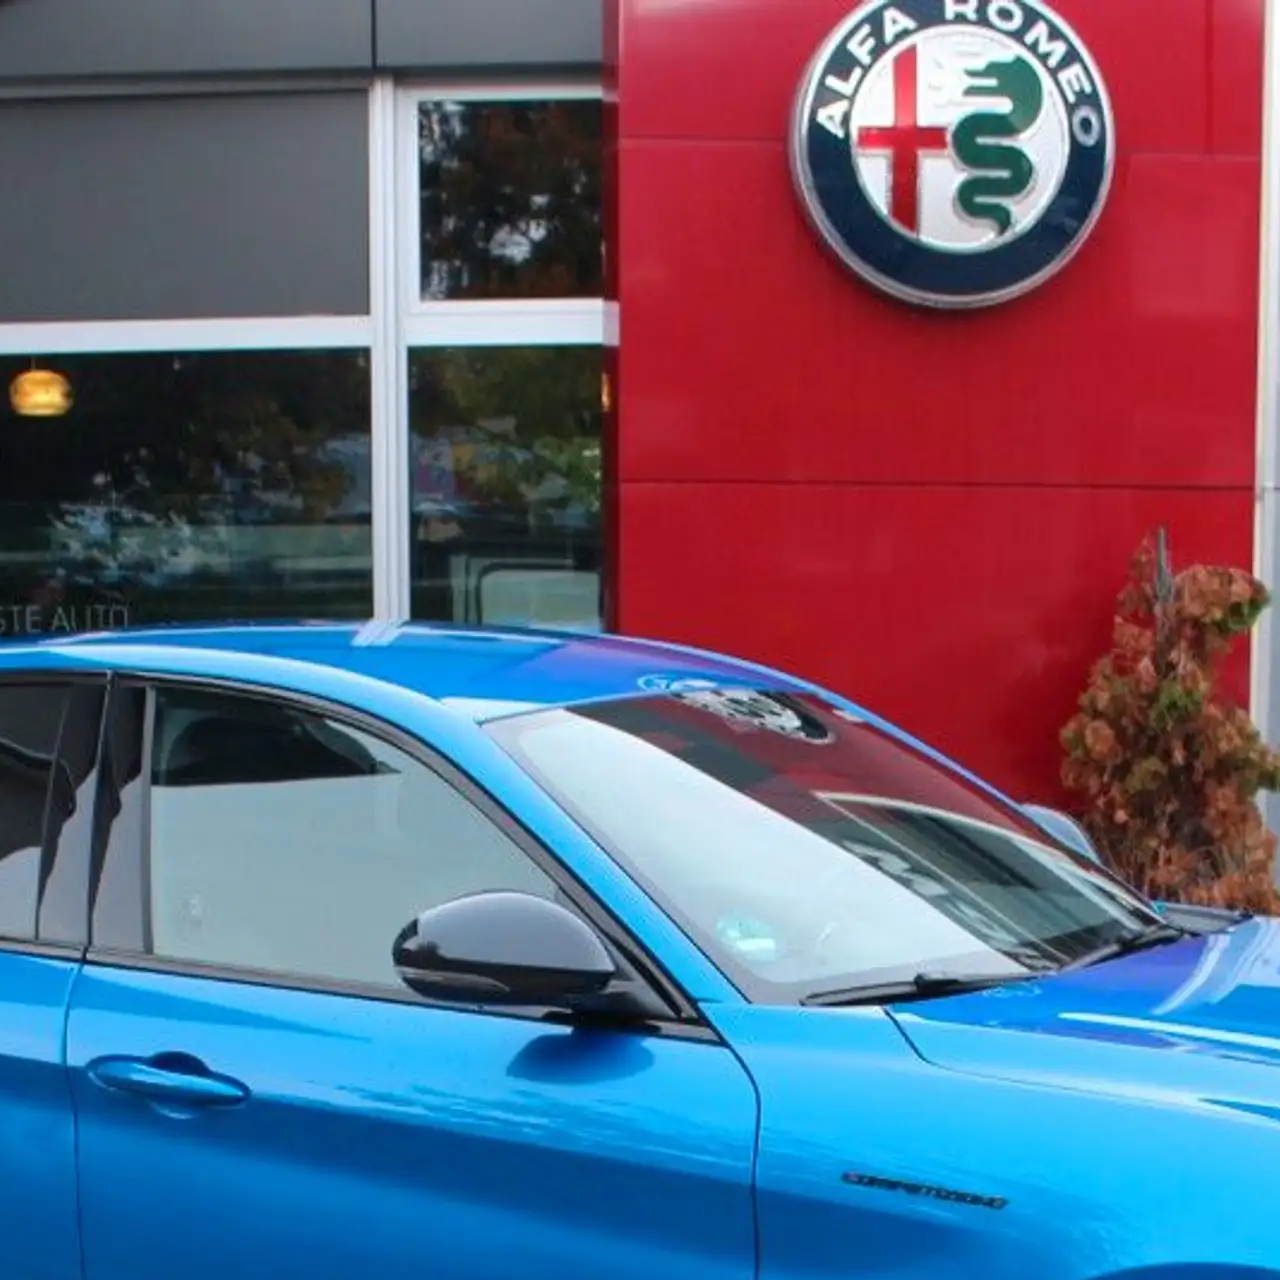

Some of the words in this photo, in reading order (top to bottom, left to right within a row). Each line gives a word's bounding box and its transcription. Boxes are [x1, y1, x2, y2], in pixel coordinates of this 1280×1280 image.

[816, 6, 917, 138] ALFA
[944, 0, 1101, 147] ROMEO
[52, 604, 130, 633] AUTO
